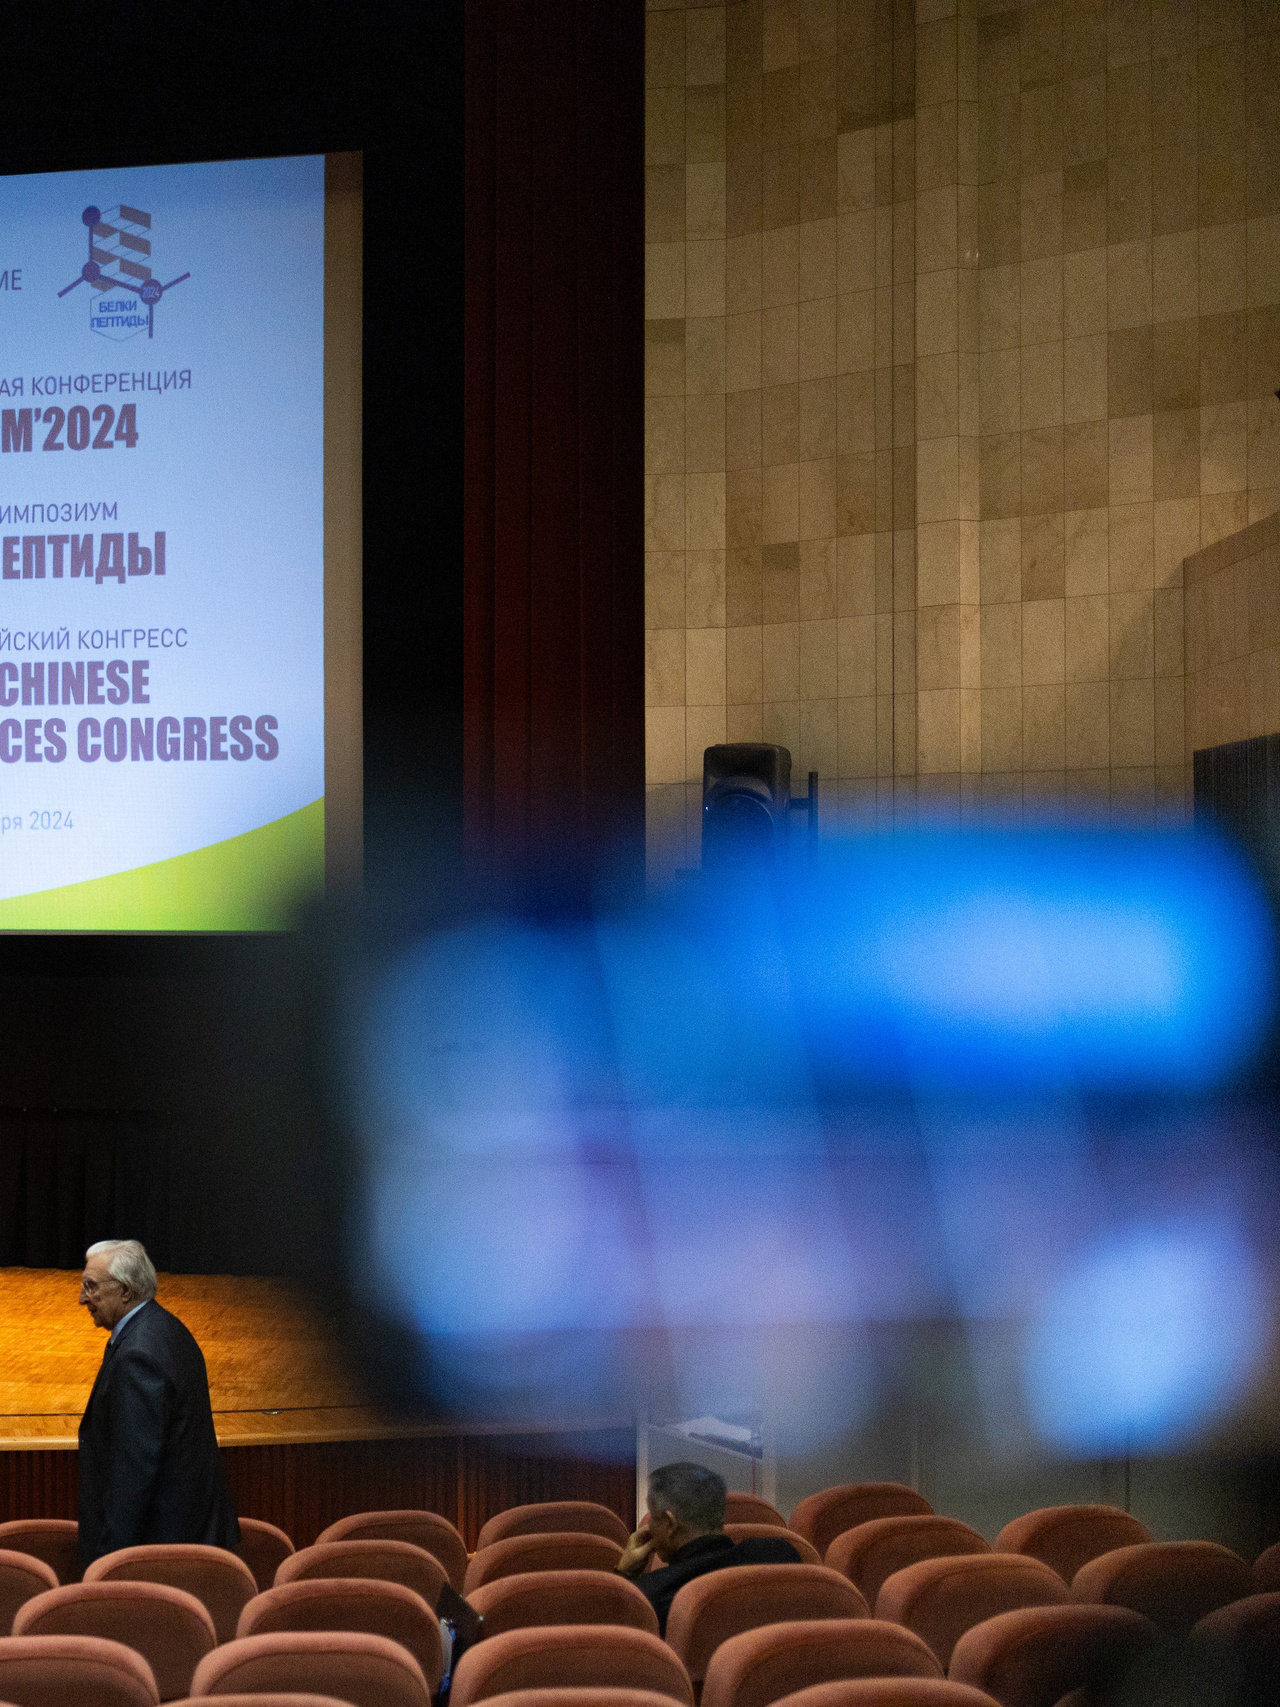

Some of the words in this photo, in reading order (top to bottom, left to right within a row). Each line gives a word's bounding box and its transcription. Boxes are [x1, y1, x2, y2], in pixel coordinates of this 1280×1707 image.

[99, 300, 137, 313] БЕЛКИ
[91, 315, 149, 329] ПЕПТИДЫ
[32, 370, 192, 397] КОНФЕРЕНЦИЯ
[78, 628, 188, 649] КОНГРЕСС
[77, 715, 279, 762] CONGRESS
[29, 811, 74, 830] 2024
